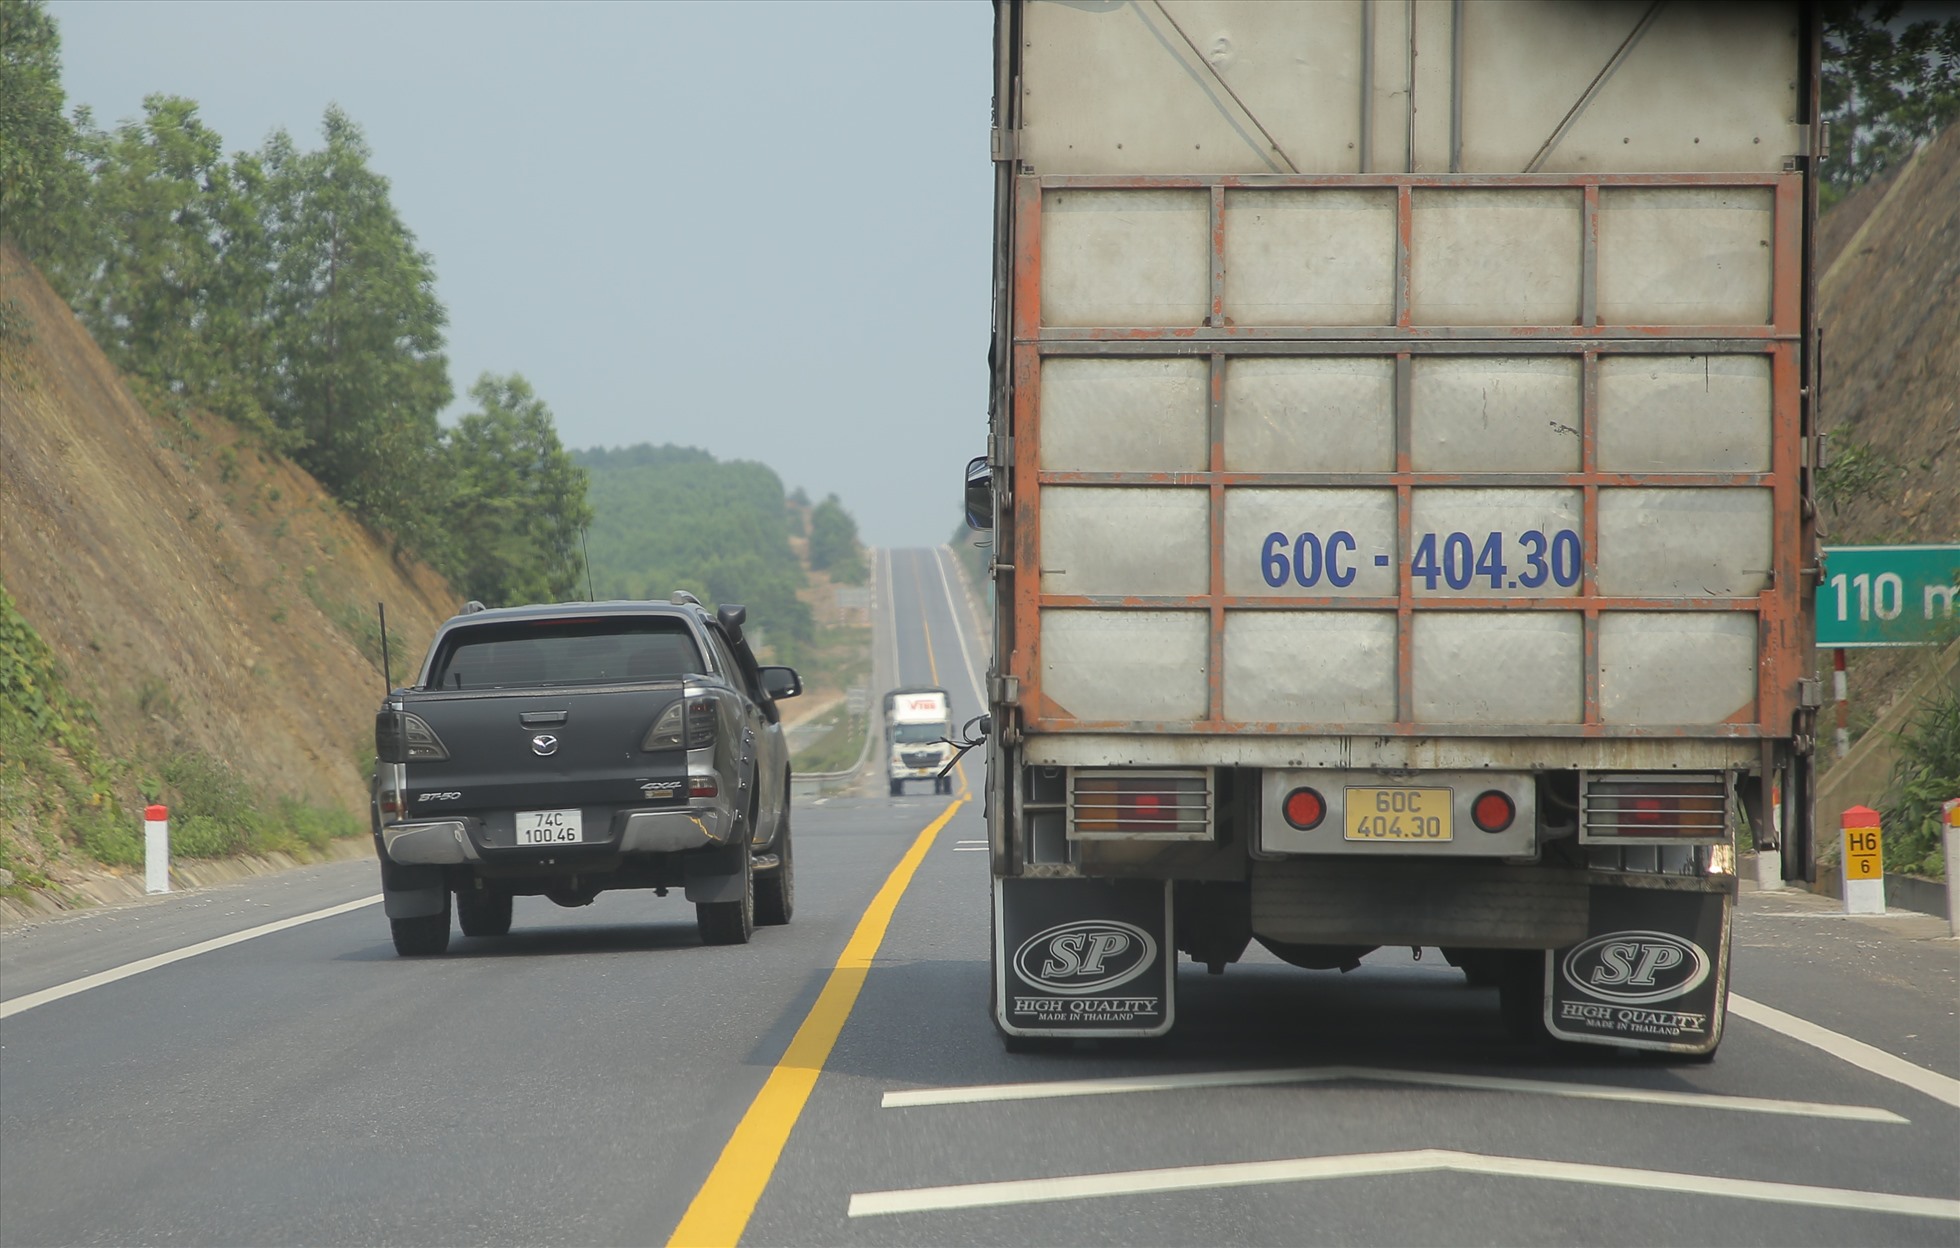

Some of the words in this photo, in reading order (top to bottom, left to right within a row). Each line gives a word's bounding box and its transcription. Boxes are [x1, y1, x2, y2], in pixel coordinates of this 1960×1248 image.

[1261, 531, 1357, 588] 60C
[1411, 530, 1582, 590] 404.30
[1831, 572, 1903, 621] 110
[1924, 584, 1960, 620] m
[418, 791, 461, 802] BT-50
[1376, 791, 1421, 812] 60C
[535, 813, 563, 827] 74C
[1357, 816, 1440, 837] 404.30
[525, 828, 575, 843] 100.46
[1849, 833, 1877, 851] H6
[1860, 859, 1870, 873] 6
[1041, 931, 1130, 978] SP
[1591, 942, 1683, 986] SP
[1014, 1000, 1063, 1012] HIGH
[1070, 1000, 1157, 1013] QUALITY
[1038, 1013, 1067, 1021] MADE
[1070, 1013, 1081, 1021] IN
[1084, 1013, 1134, 1021] THAILAND
[1562, 1004, 1612, 1020] HIGH
[1618, 1010, 1705, 1029] QUALITY
[1586, 1018, 1615, 1029] MADE
[1617, 1022, 1628, 1031] IN
[1631, 1024, 1680, 1036] THAILAND
